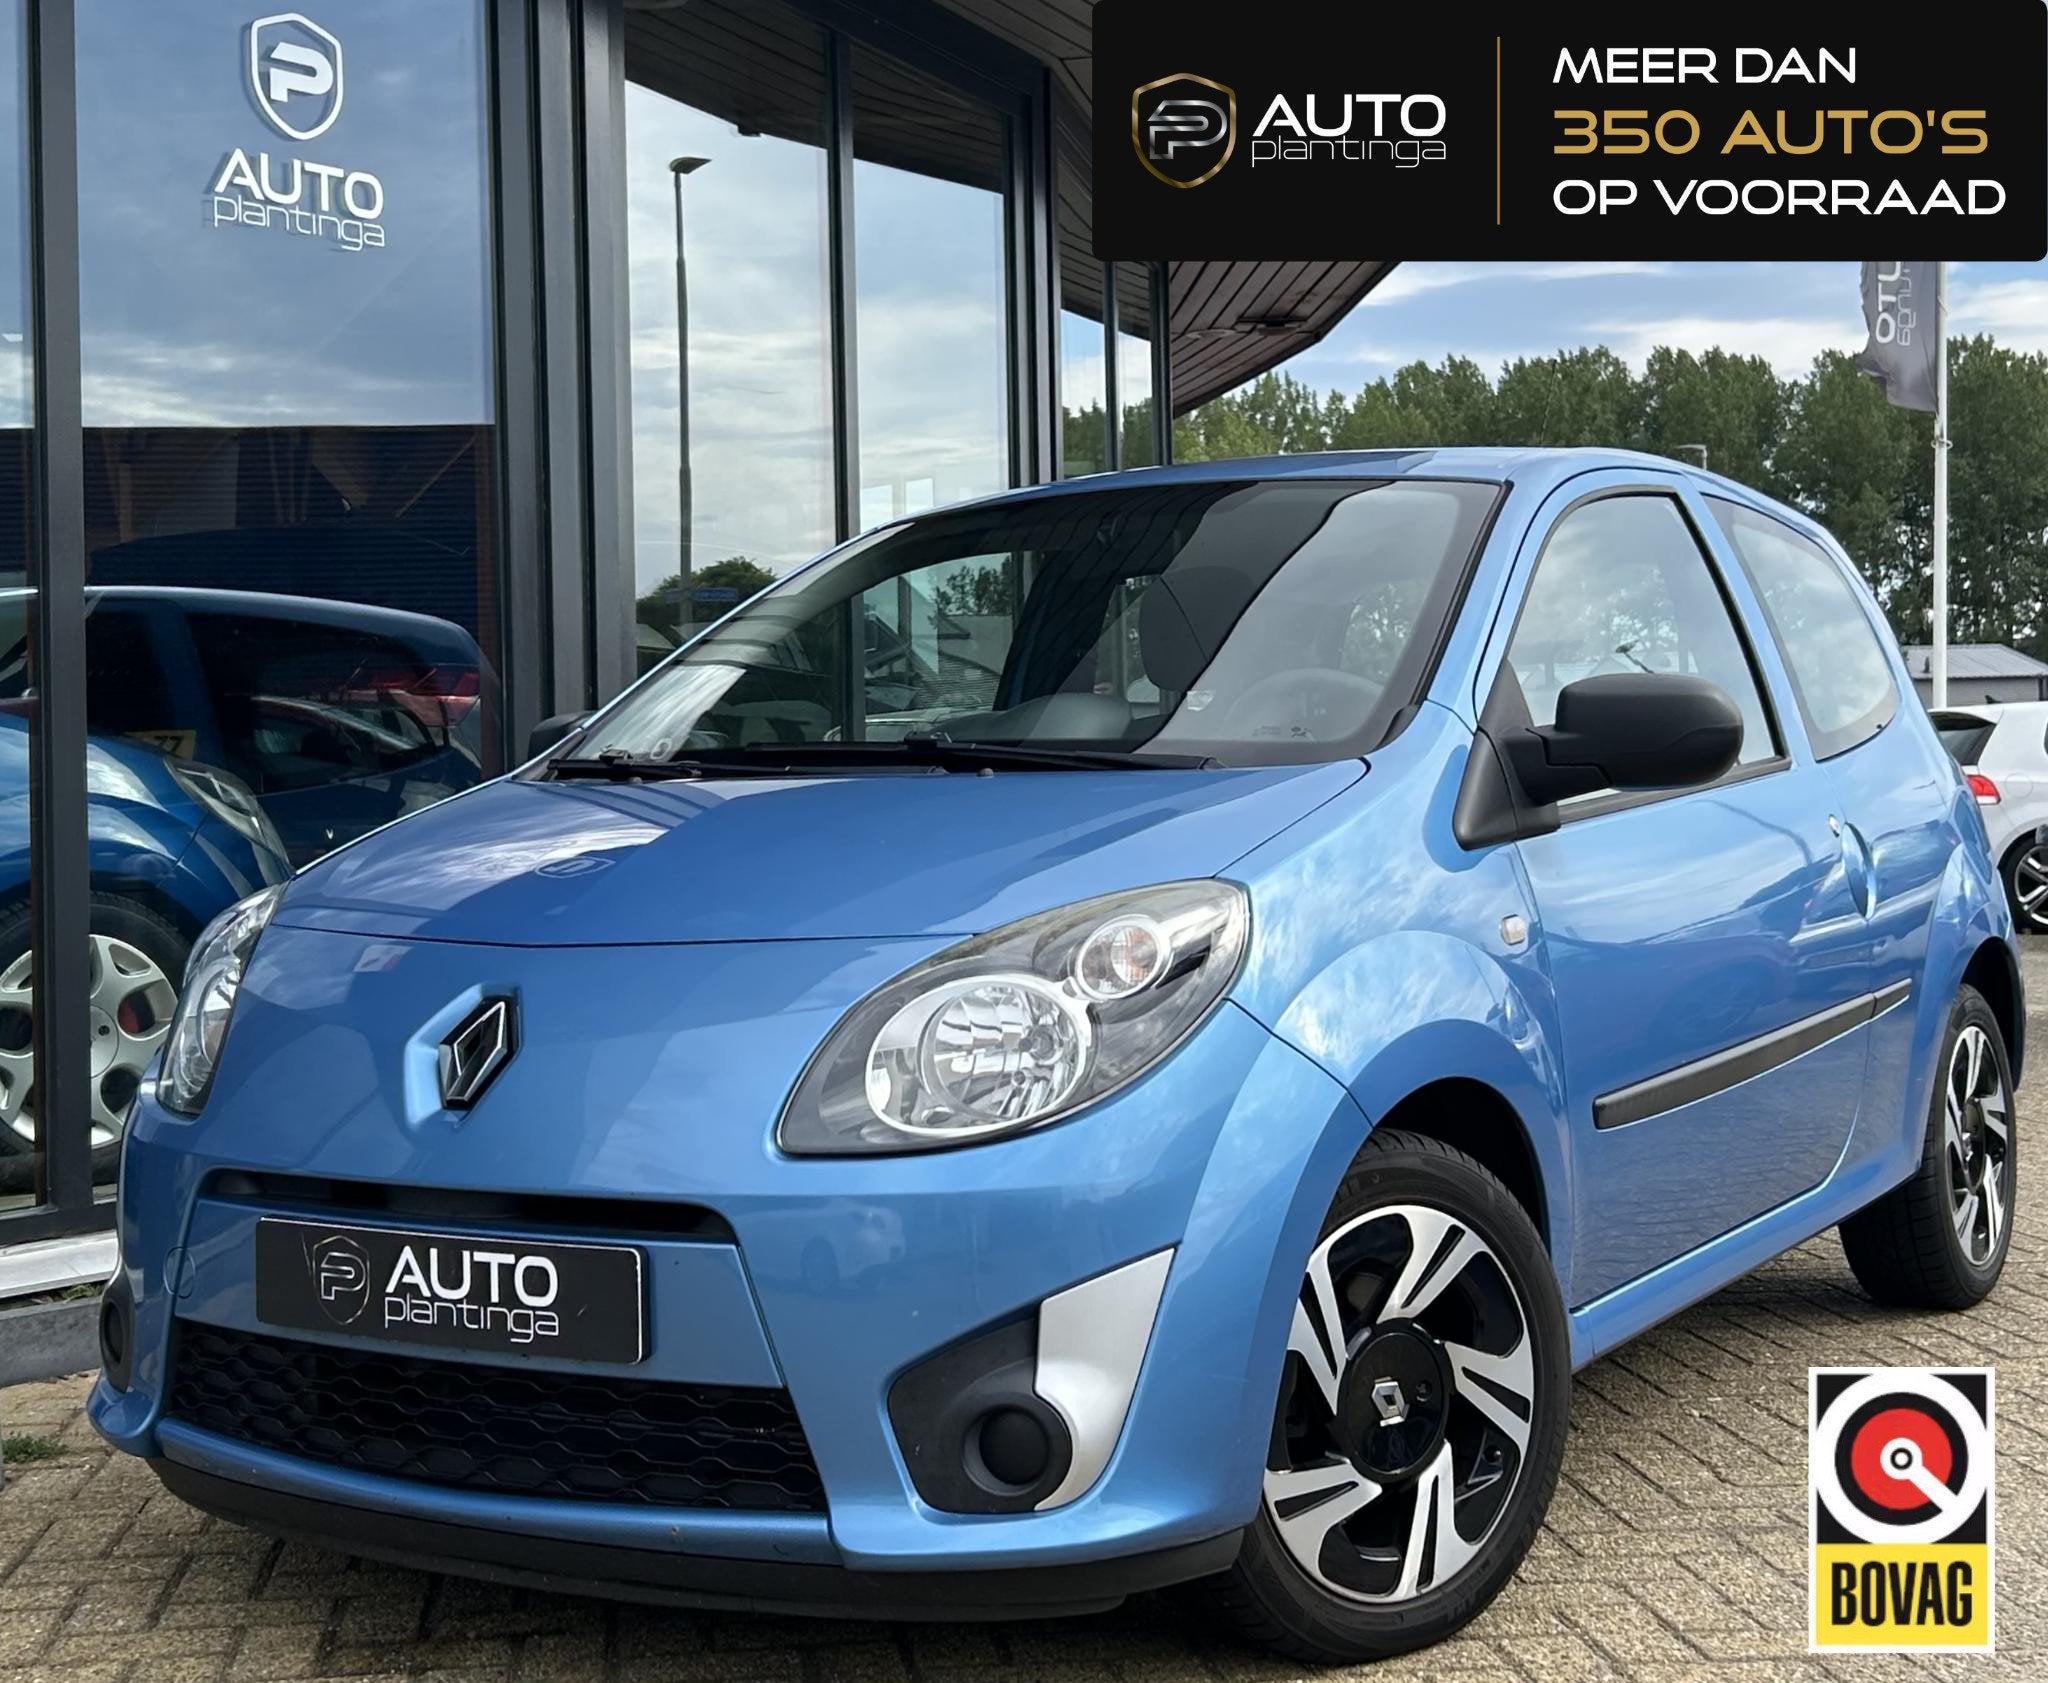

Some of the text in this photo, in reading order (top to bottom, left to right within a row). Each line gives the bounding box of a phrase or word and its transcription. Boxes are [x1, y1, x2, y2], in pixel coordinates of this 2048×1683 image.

[214, 148, 384, 220] AUTO
[213, 194, 386, 252] plantinga
[384, 1245, 559, 1308] AUTO
[384, 1293, 560, 1344] plantinga
